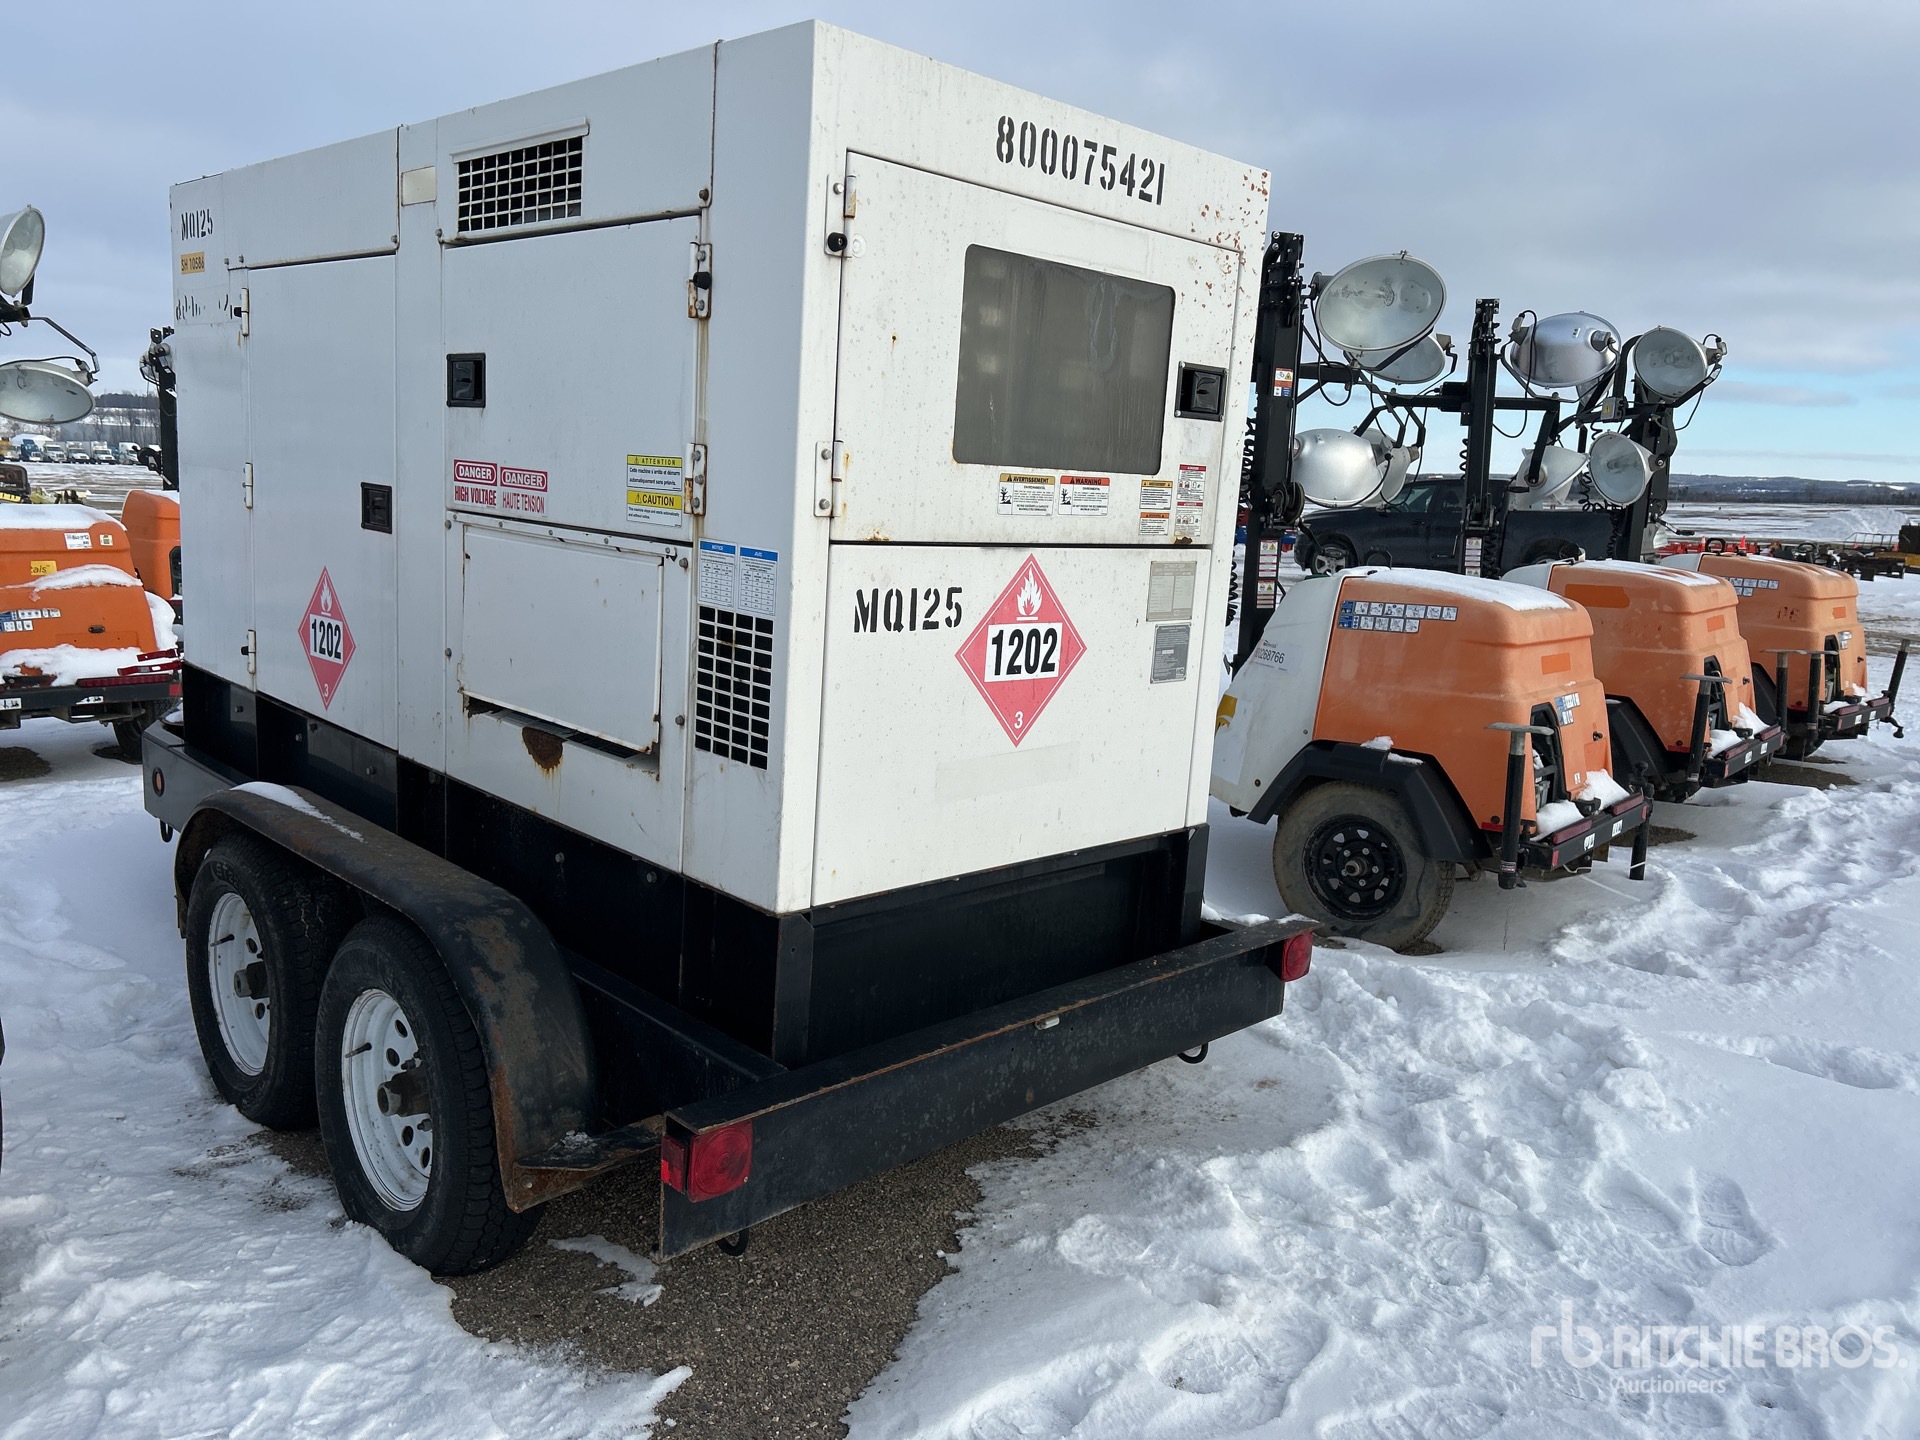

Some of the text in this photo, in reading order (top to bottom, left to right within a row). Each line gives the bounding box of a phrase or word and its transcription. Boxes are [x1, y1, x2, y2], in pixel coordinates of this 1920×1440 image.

[995, 114, 1166, 206] 800075421
[181, 259, 188, 272] SH
[641, 457, 676, 466] ATTENTION
[459, 465, 492, 480] DANGER
[505, 472, 543, 487] DANGER
[1075, 478, 1102, 486] WARNING
[454, 485, 497, 506] HIGH VOLTAGE
[502, 492, 545, 513] HAUTE TENSION
[642, 494, 675, 507] CAUTION
[853, 587, 963, 633] MQ125
[311, 618, 342, 660] 1202
[991, 627, 1058, 676] 1202
[324, 683, 329, 697] 3
[1014, 711, 1024, 729] 3
